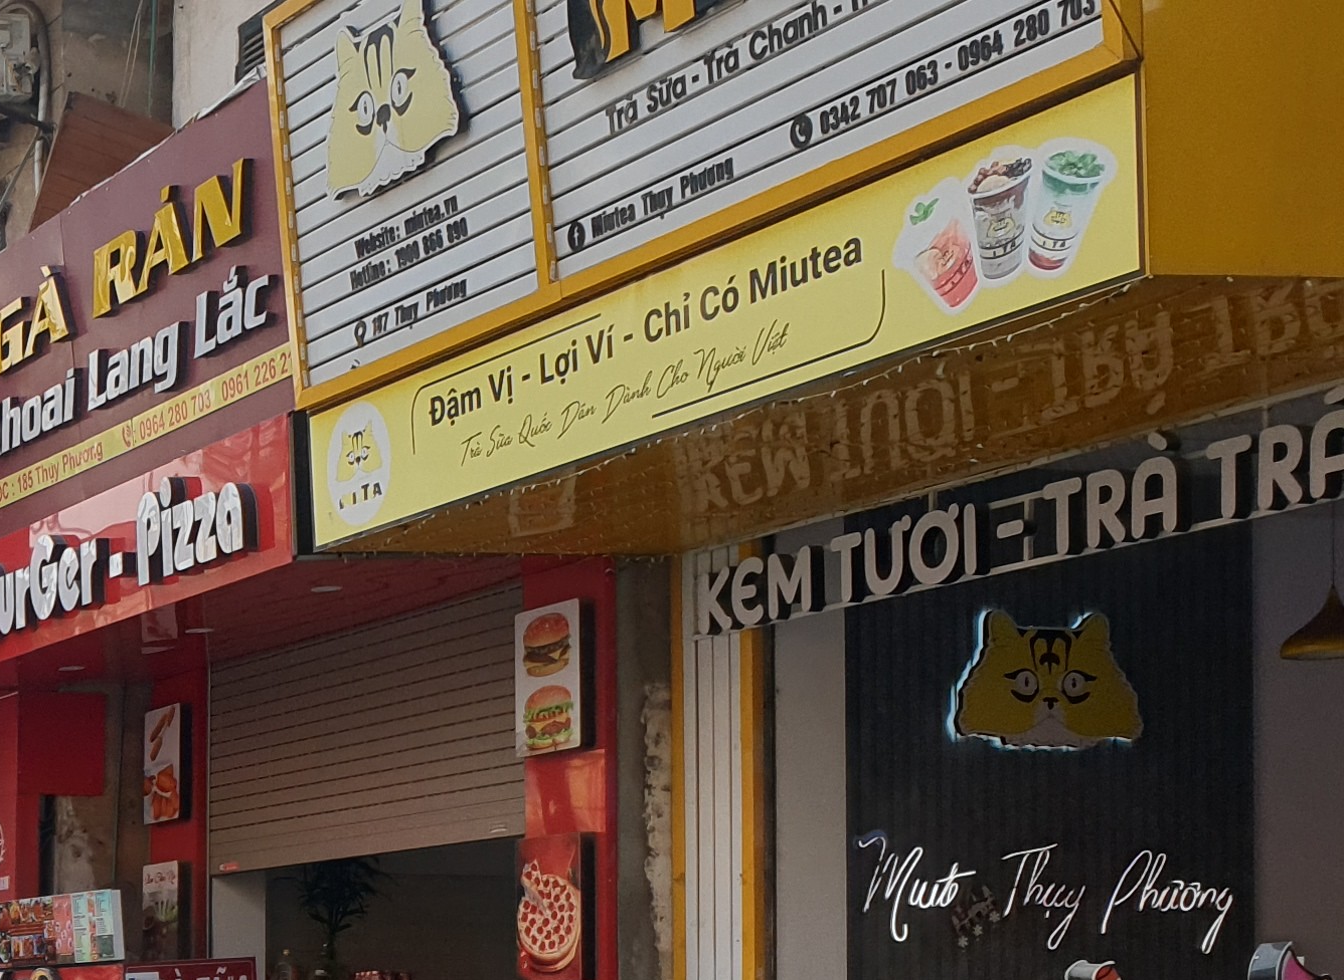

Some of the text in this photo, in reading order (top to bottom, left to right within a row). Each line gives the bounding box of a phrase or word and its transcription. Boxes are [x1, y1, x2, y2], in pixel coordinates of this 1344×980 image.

[606, 2, 828, 135] Trà Sữa Trà Chanh
[820, 0, 1096, 135] 0342 707 063 0964 280 703
[92, 157, 246, 320] RÁN
[350, 260, 391, 291] Hotline:
[394, 240, 420, 269] 1900
[446, 217, 468, 243] 890
[354, 195, 458, 260] Website: miutea.vn
[591, 156, 735, 239] Miutea Thụy Phương
[86, 320, 181, 412] Lang
[194, 265, 270, 358] Lắc
[426, 279, 467, 312] Phương
[429, 236, 863, 427] Đậm Vị Lợi Ví Chỉ Có Miutea
[17, 470, 33, 492] 185
[35, 460, 59, 484] Thụy
[139, 413, 165, 441] 0964
[168, 400, 187, 428] 280
[191, 392, 211, 415] 703
[221, 372, 249, 402] 0961
[255, 358, 276, 387] 226
[601, 372, 651, 424] Dành
[656, 366, 690, 398] Cho
[694, 344, 747, 392] Người
[137, 476, 244, 586] Pizza
[697, 545, 813, 637] KEM
[830, 502, 978, 604] TƯƠI
[1043, 432, 1177, 556] TRÀ
